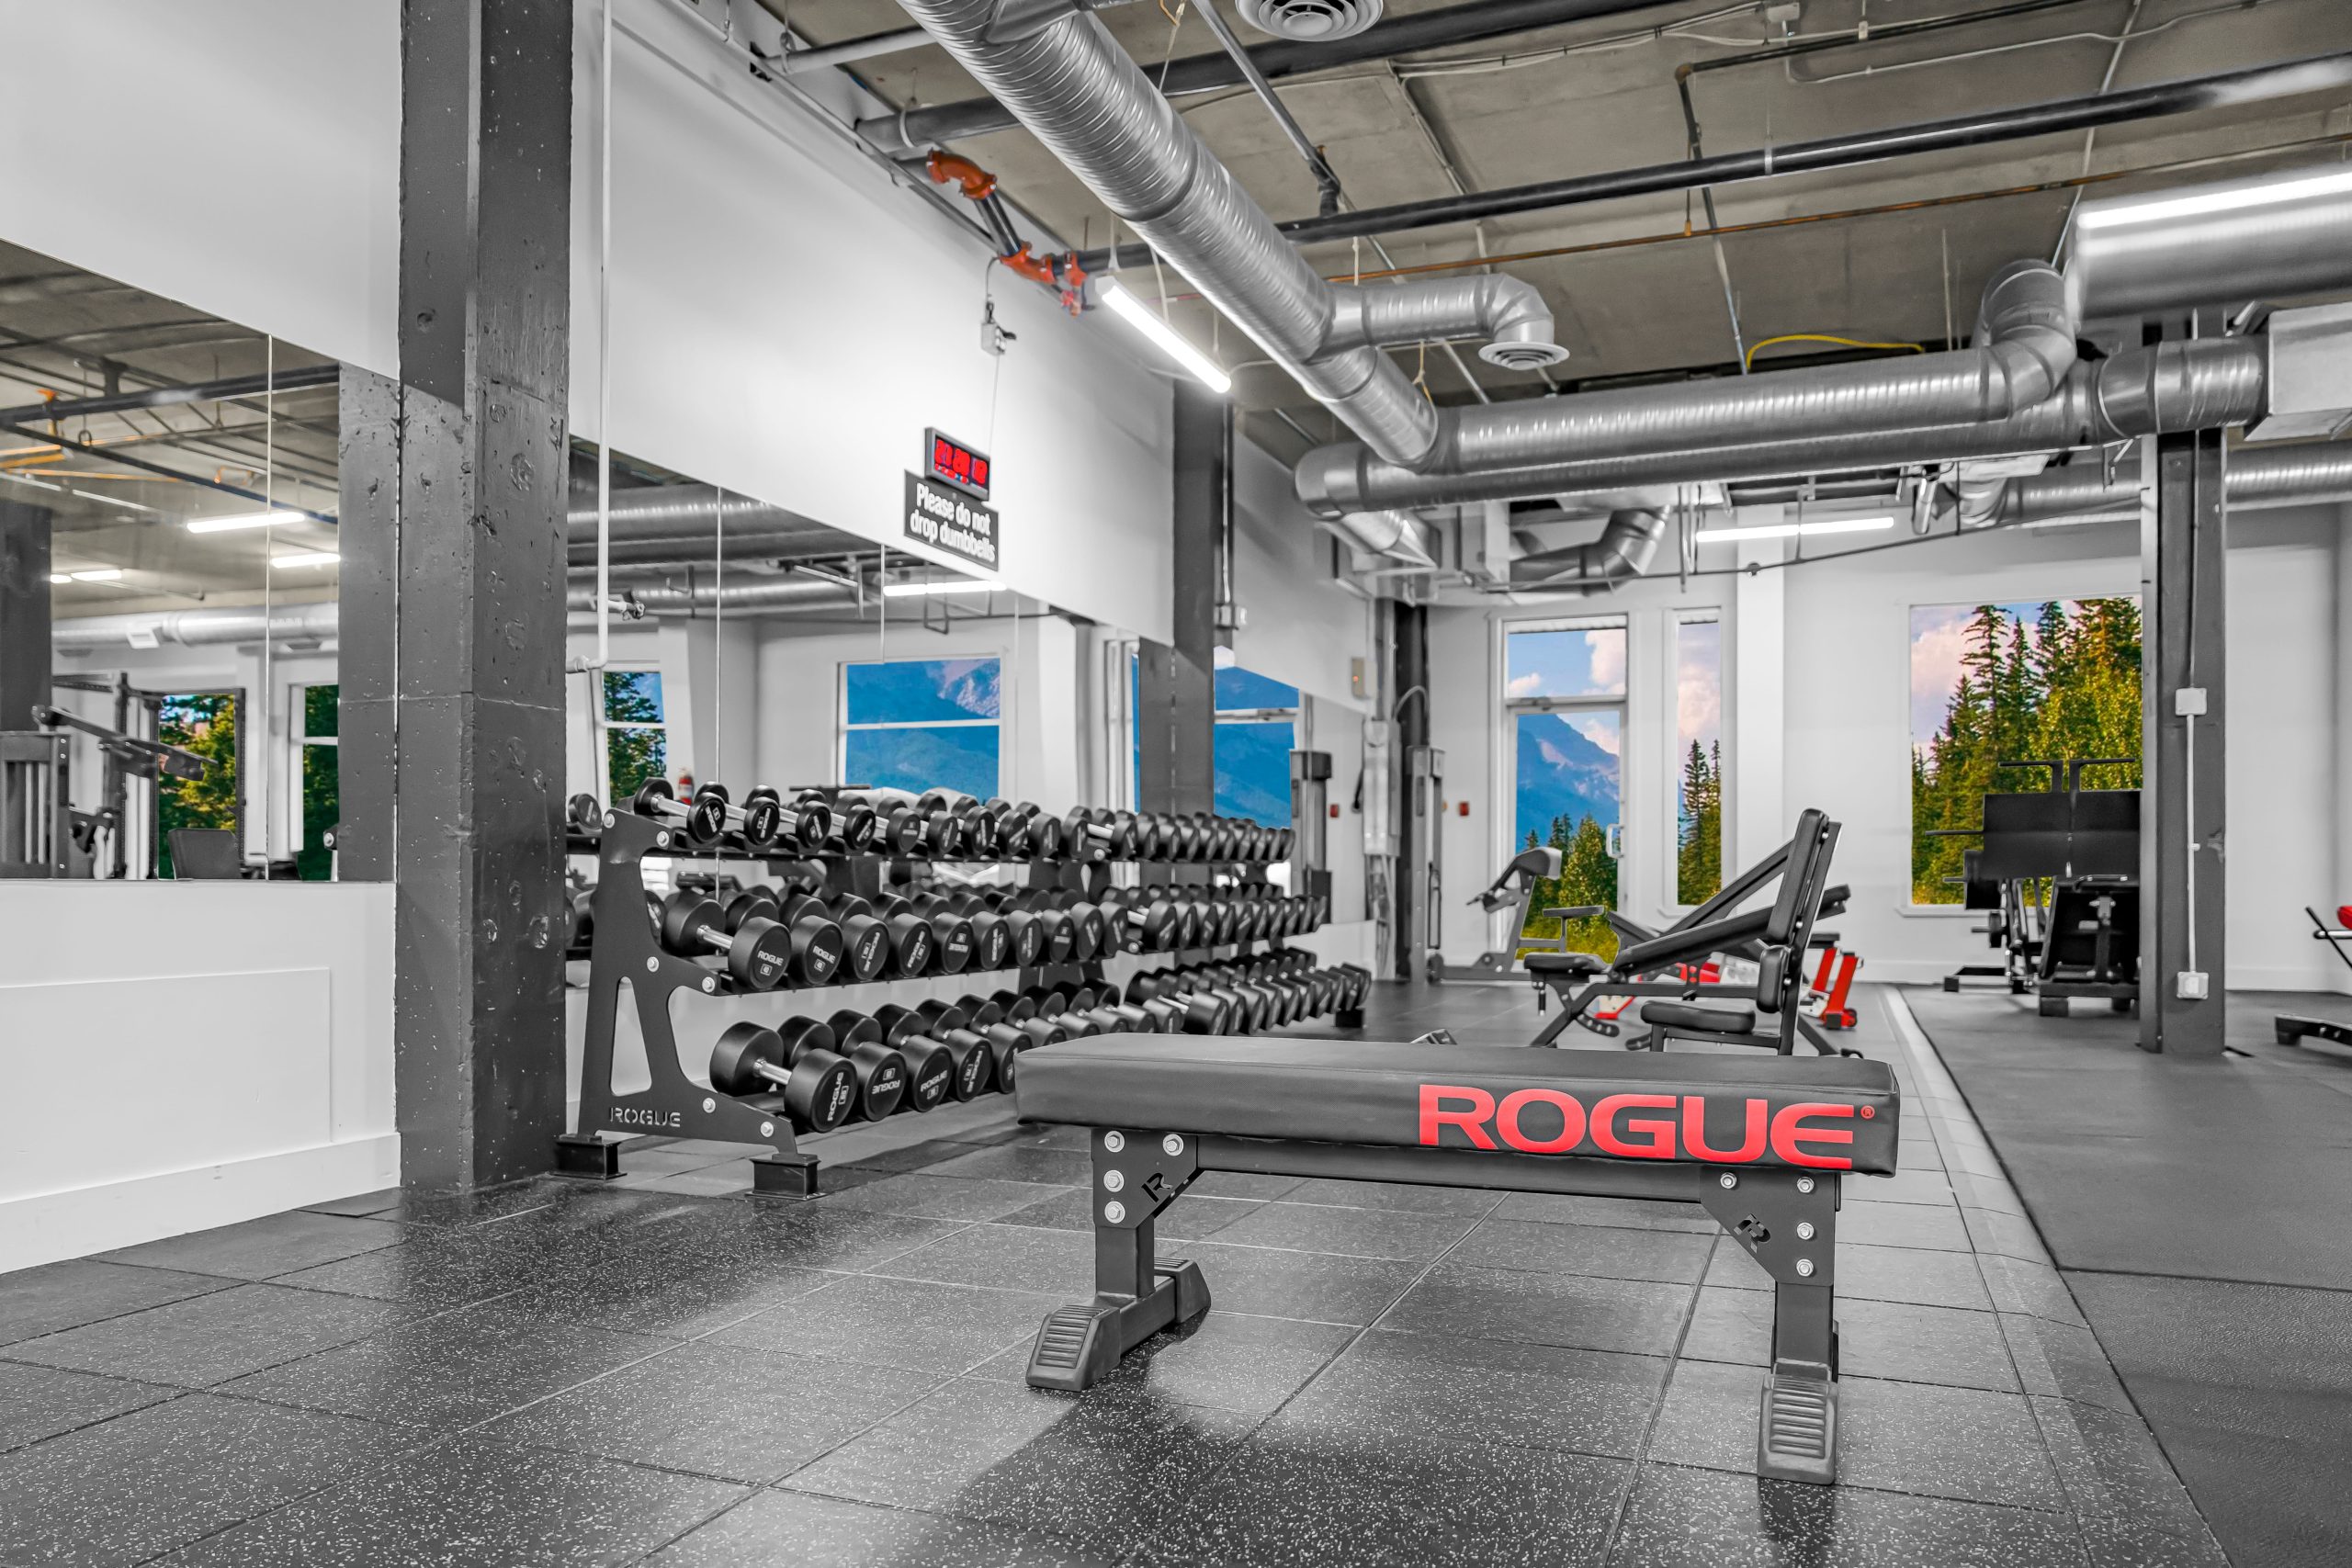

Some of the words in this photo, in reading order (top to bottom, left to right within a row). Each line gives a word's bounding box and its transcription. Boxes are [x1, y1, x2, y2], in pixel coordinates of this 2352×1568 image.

[916, 482, 955, 521] Please
[956, 502, 971, 527] do
[972, 512, 991, 536] not
[910, 509, 938, 544] drop
[939, 521, 996, 562] dumbbells
[757, 950, 784, 966] ROGUE
[812, 944, 836, 964] ROGUE
[872, 1079, 900, 1095] ROGUE
[921, 1069, 948, 1093] ROGUE
[827, 1071, 844, 1122] ROGUE
[609, 1107, 681, 1128] ROGUE
